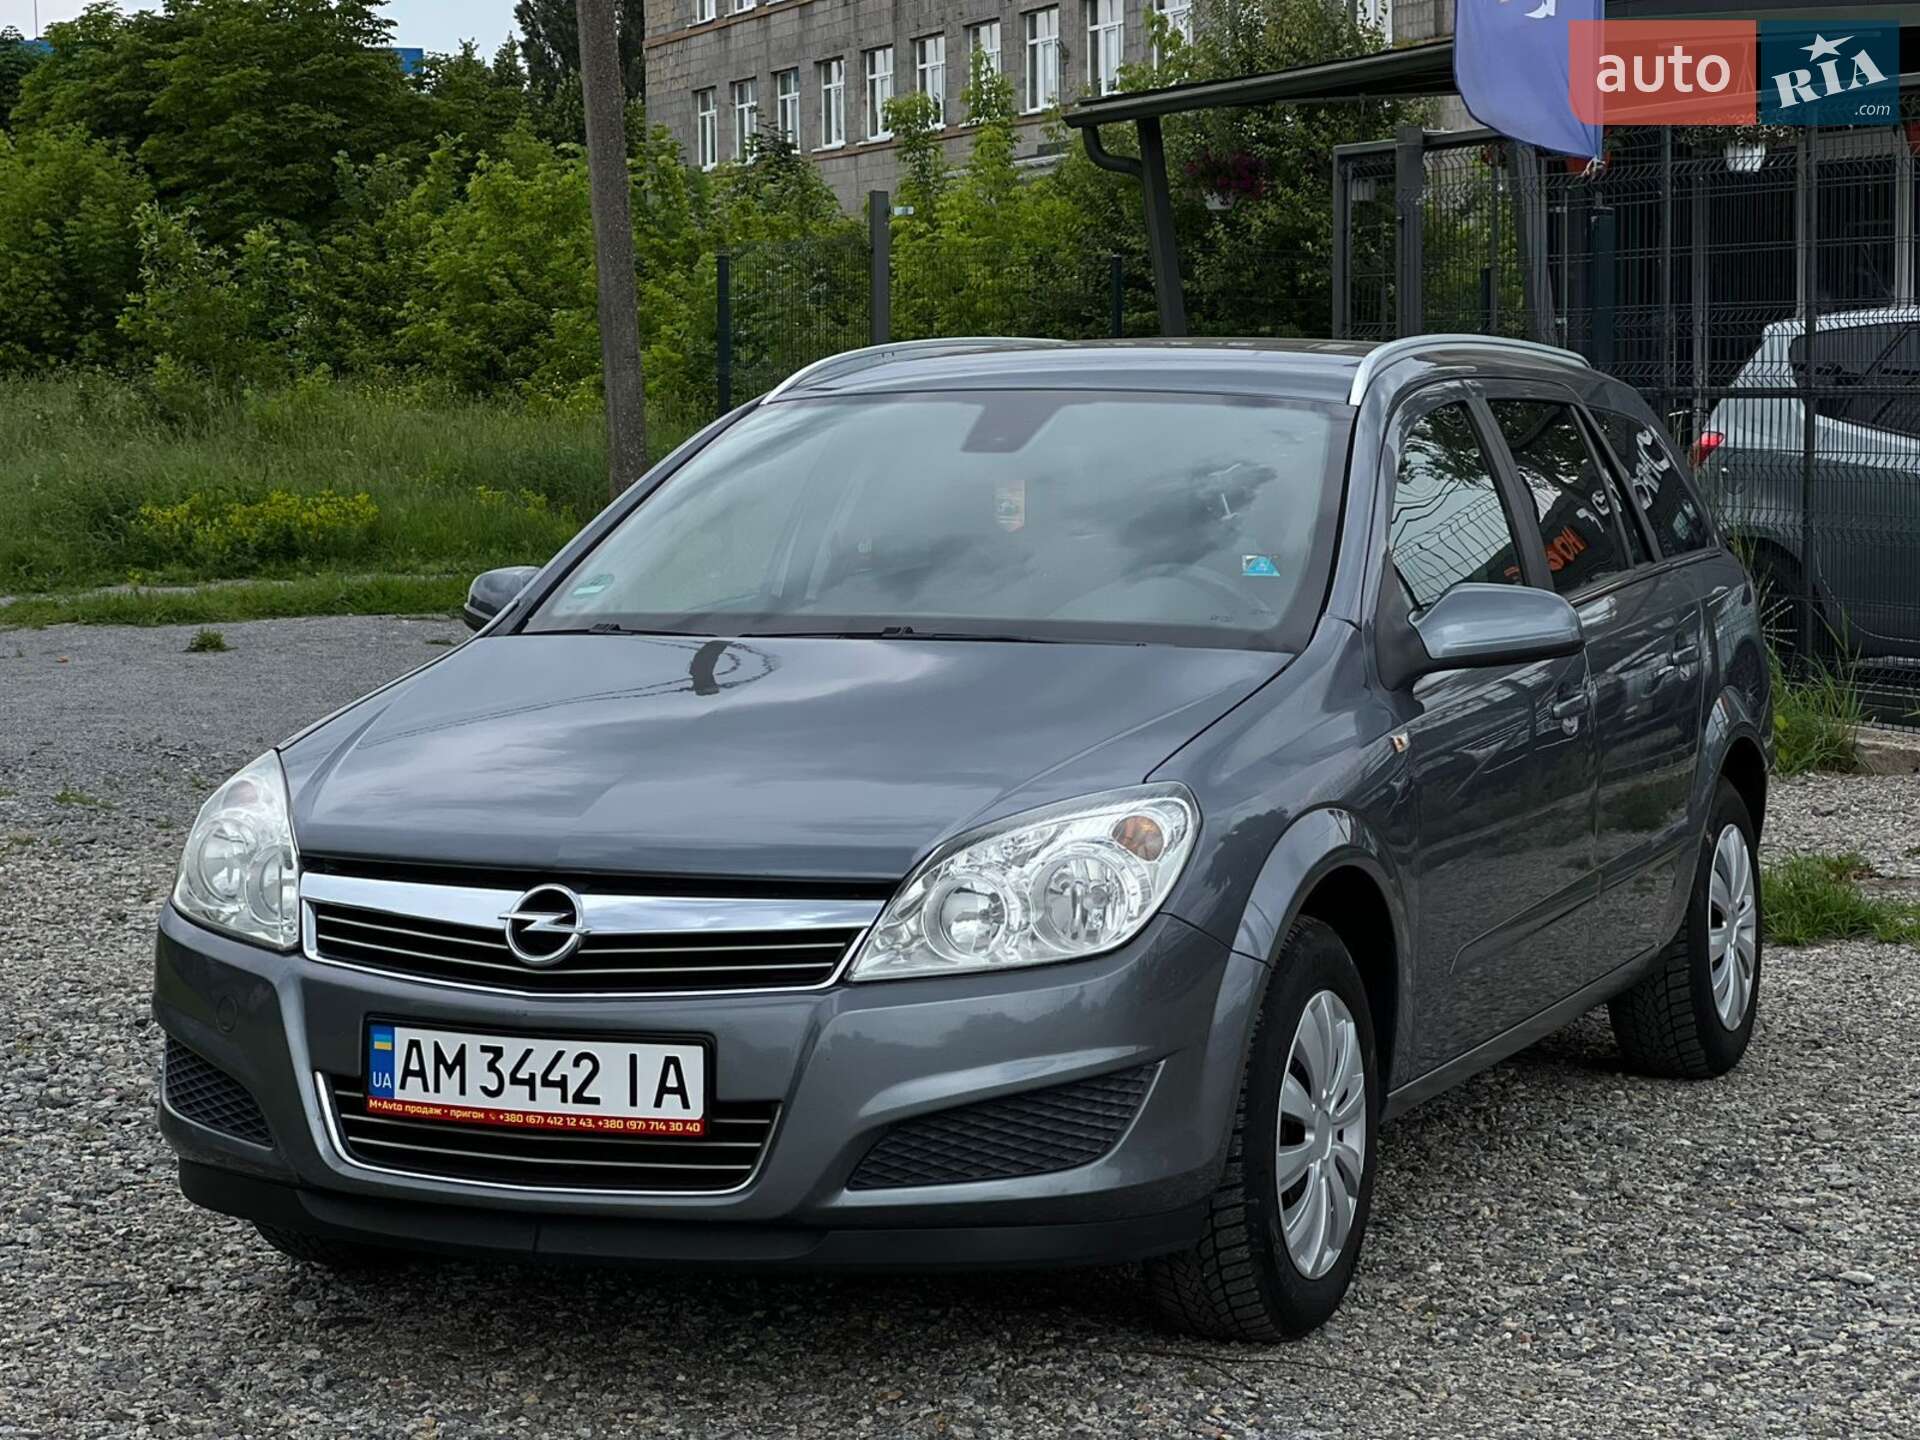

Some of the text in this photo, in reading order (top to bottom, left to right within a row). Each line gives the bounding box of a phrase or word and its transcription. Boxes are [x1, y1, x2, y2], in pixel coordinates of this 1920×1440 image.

[373, 1071, 392, 1089] UA
[399, 1038, 467, 1097] AM
[479, 1044, 601, 1106] 3442
[405, 1104, 442, 1115] продаж
[450, 1108, 485, 1119] пригон
[499, 1112, 523, 1123] +380
[526, 1114, 545, 1125] (67)
[546, 1116, 564, 1126] 412
[566, 1117, 577, 1127] 12
[598, 1119, 624, 1129] +380
[626, 1120, 646, 1130] (97)
[648, 1121, 666, 1131] 714
[668, 1122, 684, 1132] 30
[685, 1122, 701, 1133] 40
